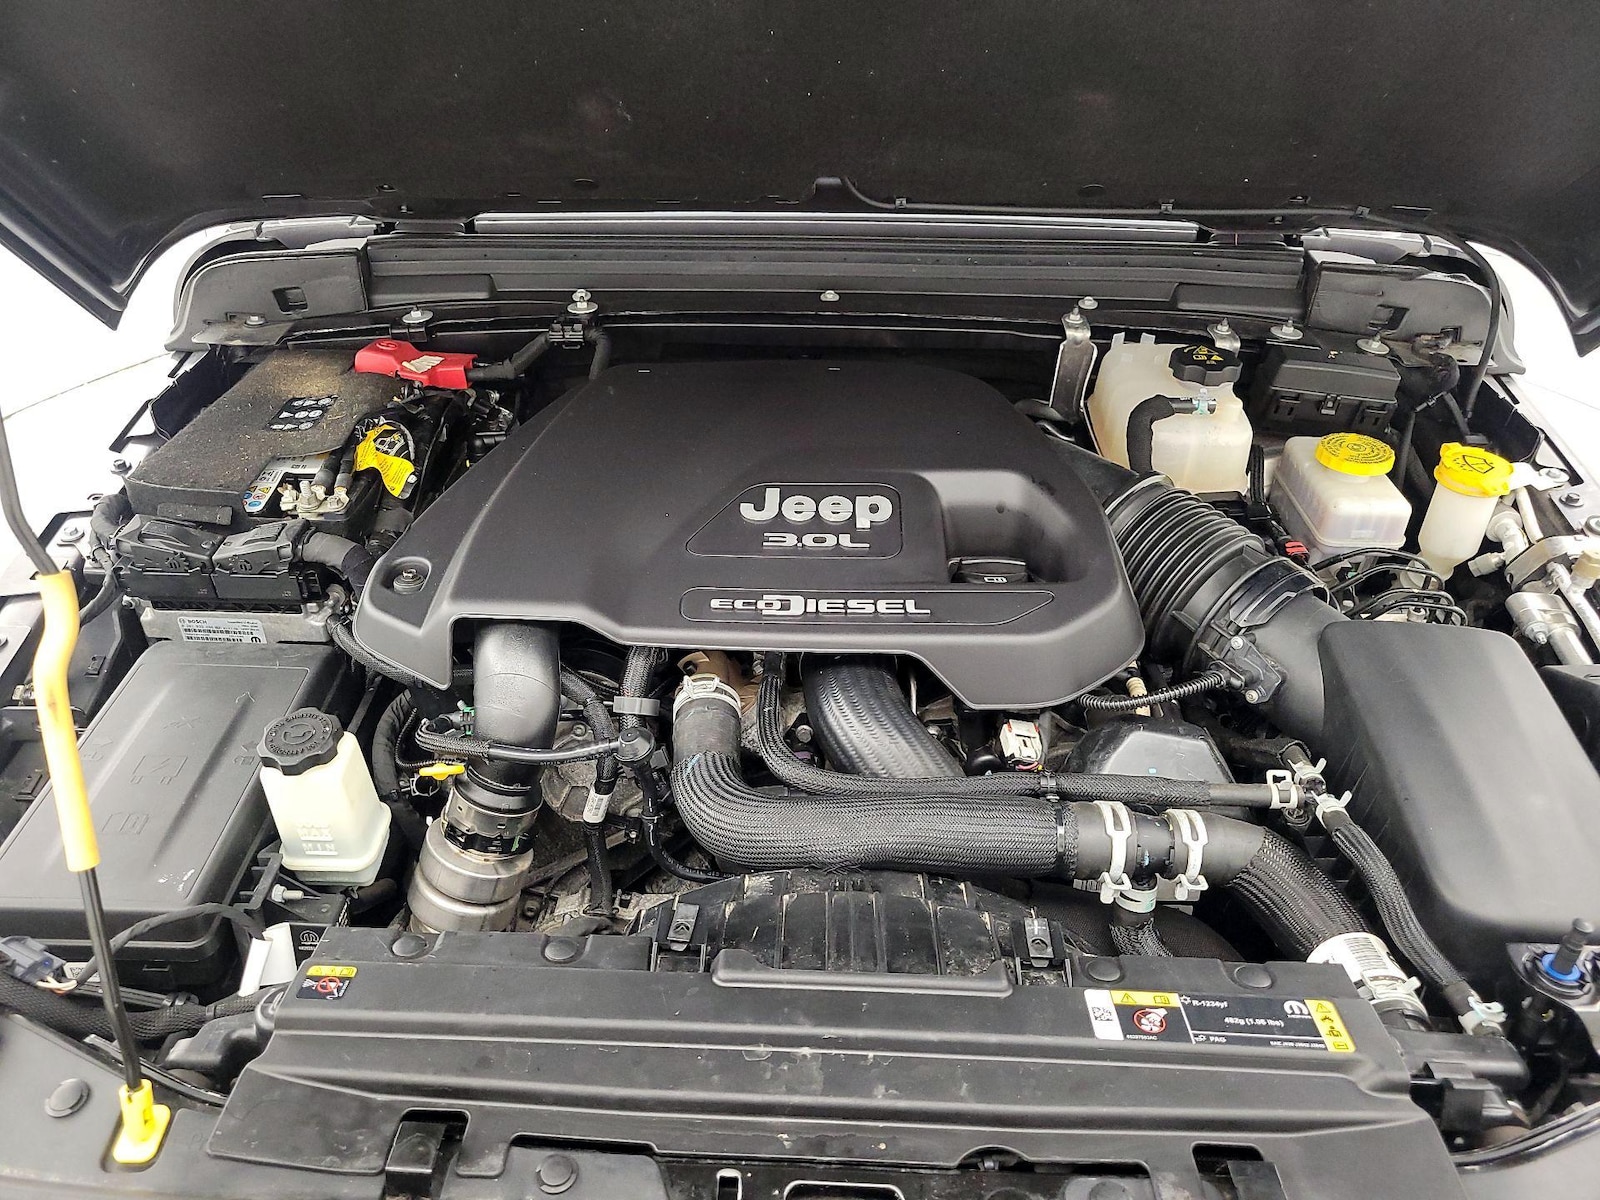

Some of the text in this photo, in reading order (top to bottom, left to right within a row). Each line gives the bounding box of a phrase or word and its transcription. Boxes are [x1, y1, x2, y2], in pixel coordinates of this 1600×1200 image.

[740, 488, 893, 531] Jeep
[763, 532, 870, 549] 3.0L
[302, 843, 336, 852] MIN
[1192, 999, 1228, 1009] R-1234yf
